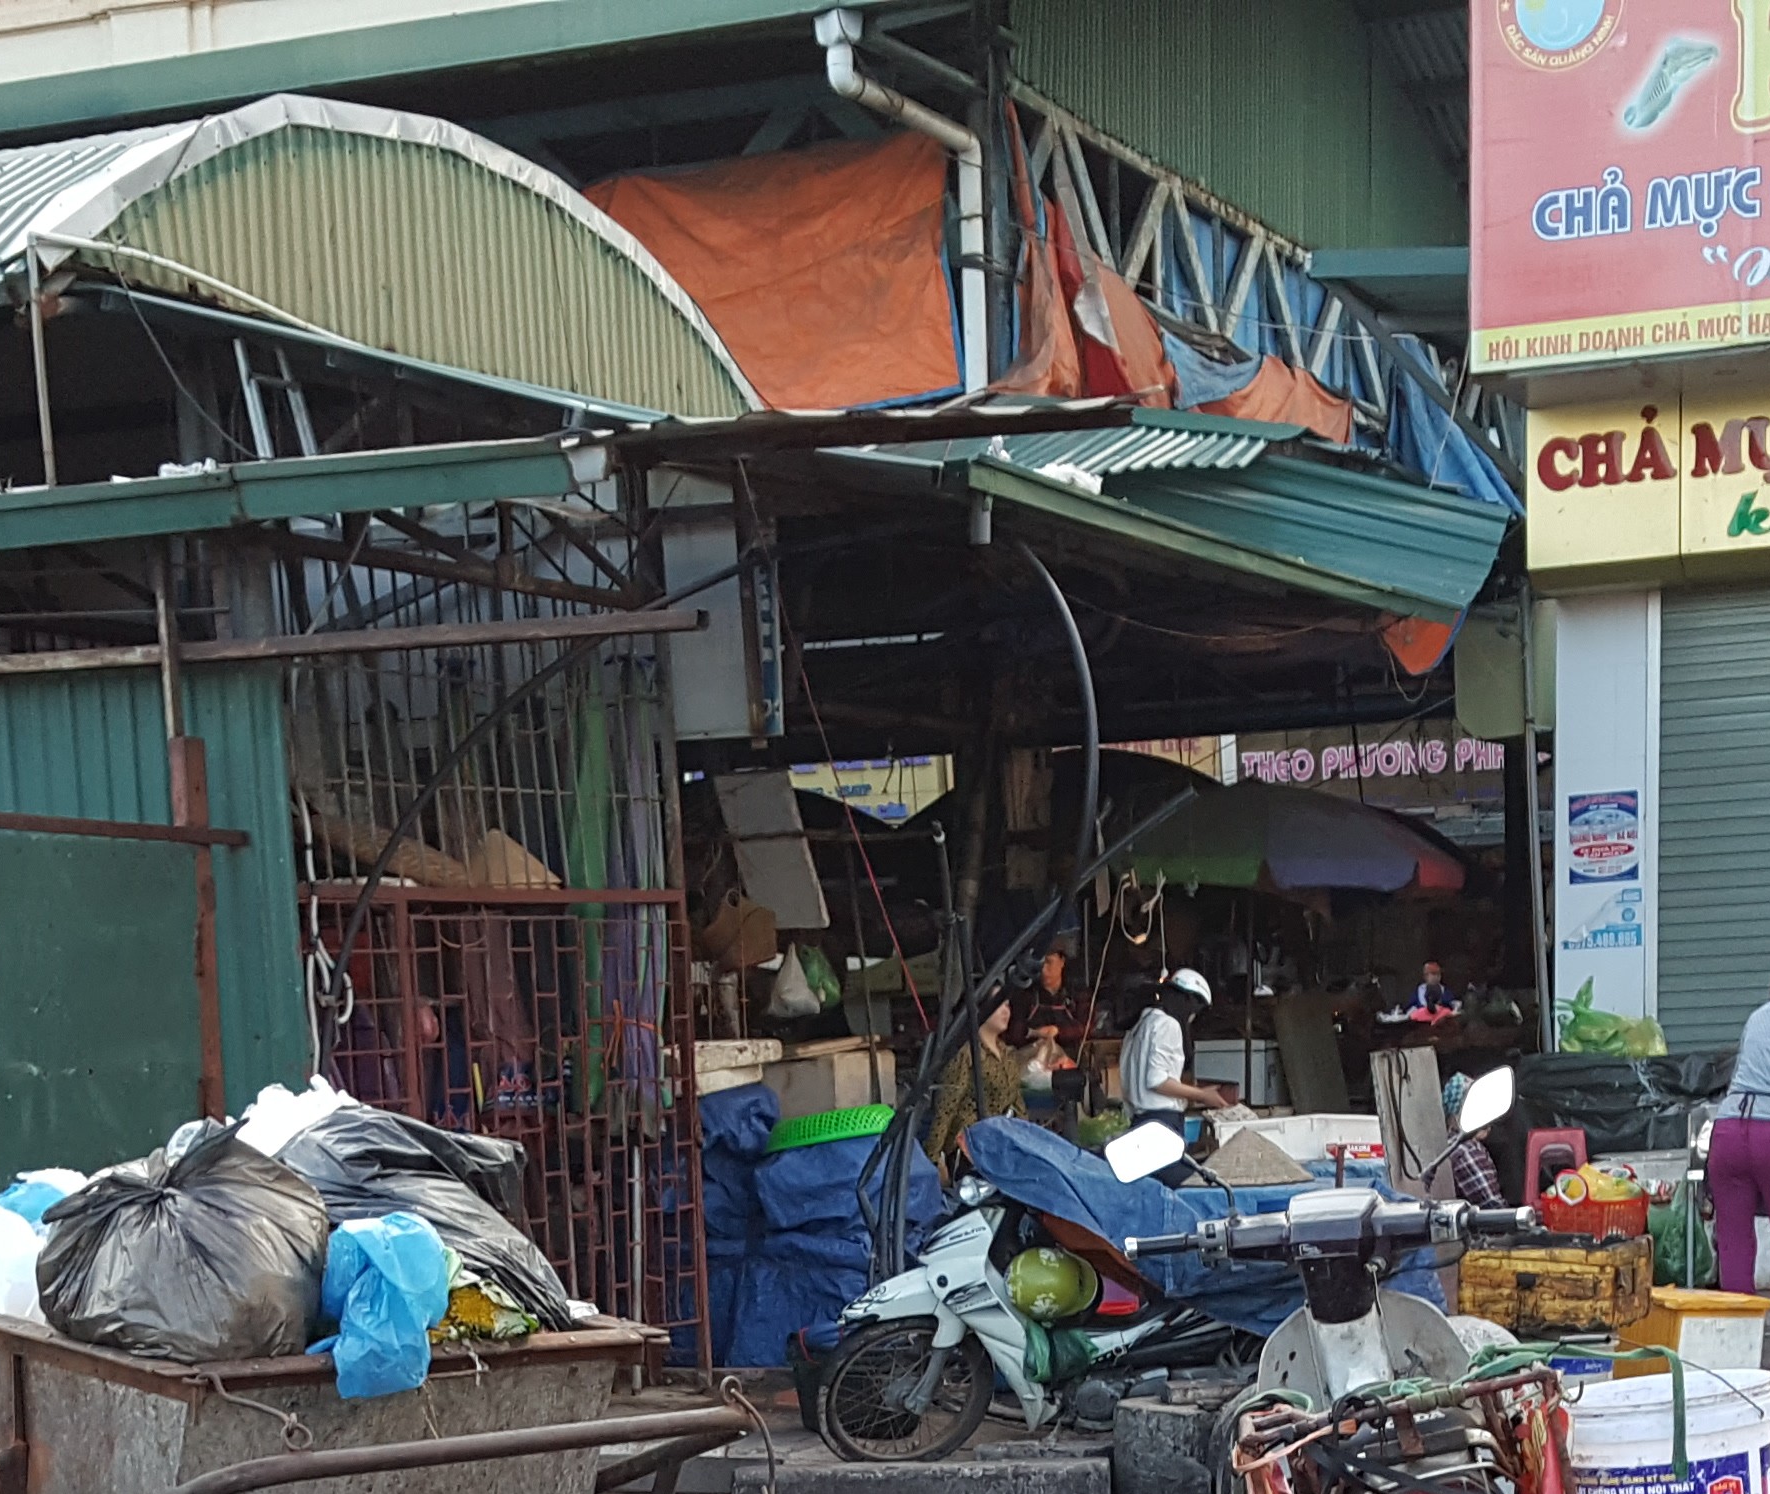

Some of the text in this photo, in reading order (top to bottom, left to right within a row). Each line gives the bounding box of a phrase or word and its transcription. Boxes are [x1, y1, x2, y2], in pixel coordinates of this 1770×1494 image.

[1533, 166, 1632, 241] CHẢ
[1644, 166, 1762, 239] MỰC
[1488, 335, 1521, 364] HỘI
[1527, 331, 1572, 358] KINH
[1579, 327, 1645, 355] DOANH
[1651, 312, 1690, 343] CHẢ
[1697, 312, 1742, 342] MỰC
[1537, 404, 1677, 491] CHẢ
[1241, 747, 1314, 784] THEO
[1322, 737, 1448, 781] PHƯƠNG
